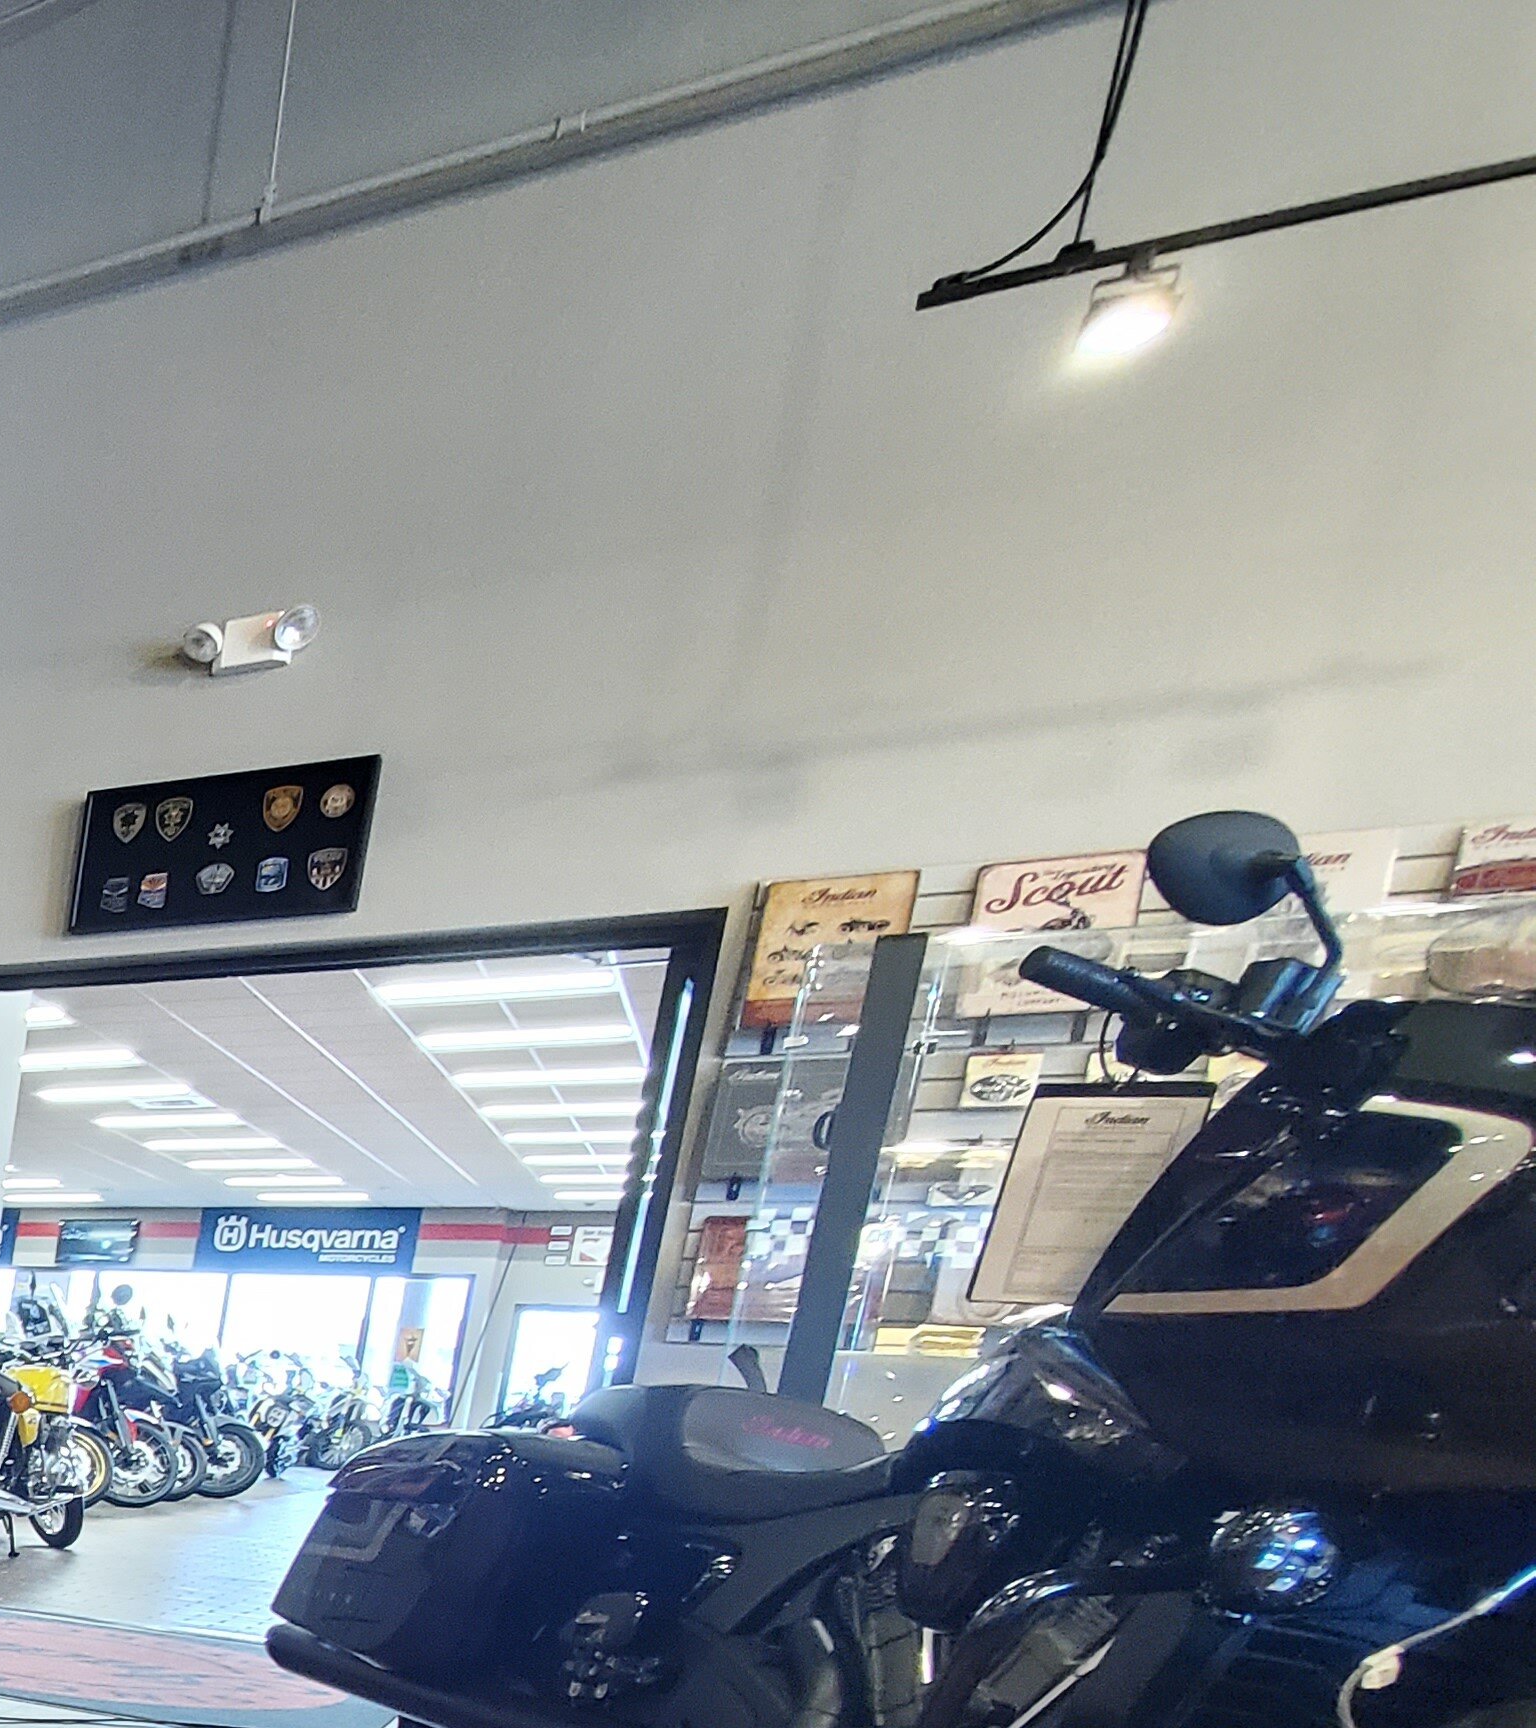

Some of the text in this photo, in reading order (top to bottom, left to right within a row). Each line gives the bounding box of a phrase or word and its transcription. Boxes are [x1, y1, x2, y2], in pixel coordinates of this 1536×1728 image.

[801, 887, 877, 904] Indian
[985, 866, 1129, 914] Scout
[1084, 1111, 1150, 1126] Indian
[248, 1223, 399, 1254] Husqvarna
[318, 1253, 396, 1264] MOTORCYCLES
